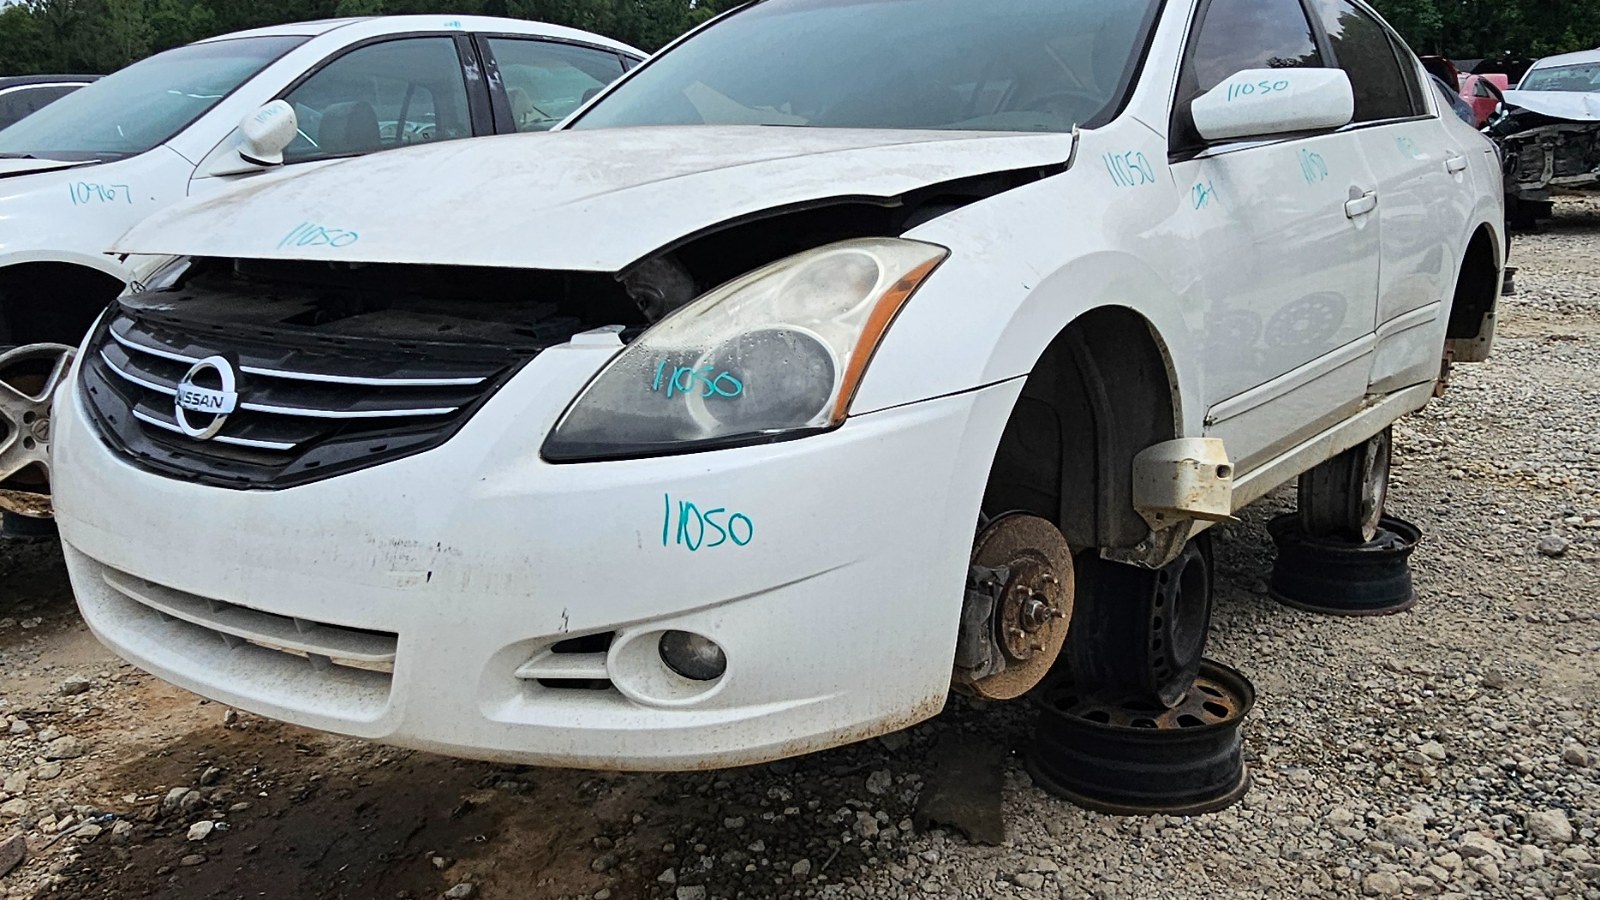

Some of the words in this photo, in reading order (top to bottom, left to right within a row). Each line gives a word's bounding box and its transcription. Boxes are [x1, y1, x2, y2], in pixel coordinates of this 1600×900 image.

[1228, 80, 1288, 102] 11050
[1102, 150, 1155, 188] 11050
[69, 181, 132, 205] 10967
[276, 222, 359, 250] 11050
[652, 359, 743, 399] 11050
[662, 492, 754, 552] 11050
